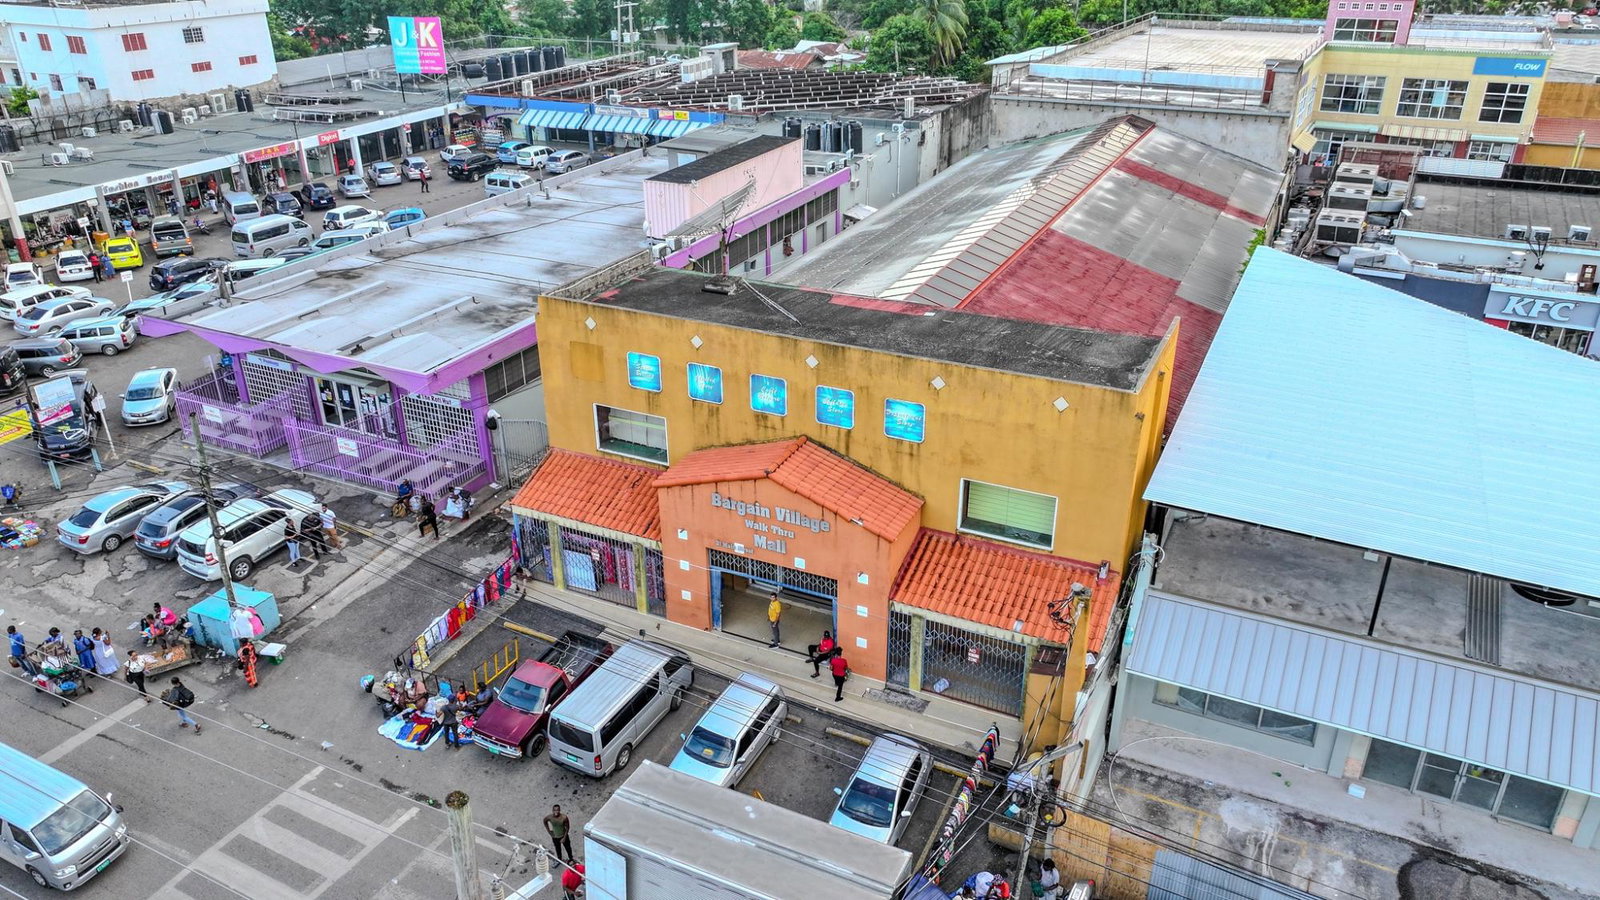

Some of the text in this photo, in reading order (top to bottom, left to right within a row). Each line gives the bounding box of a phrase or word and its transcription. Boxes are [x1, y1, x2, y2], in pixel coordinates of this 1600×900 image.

[394, 22, 407, 47] J
[419, 22, 438, 47] K
[1501, 296, 1575, 321] KFC
[711, 492, 831, 533] Bargain Village
[745, 519, 795, 538] Walk Thru
[753, 534, 786, 554] Mall
